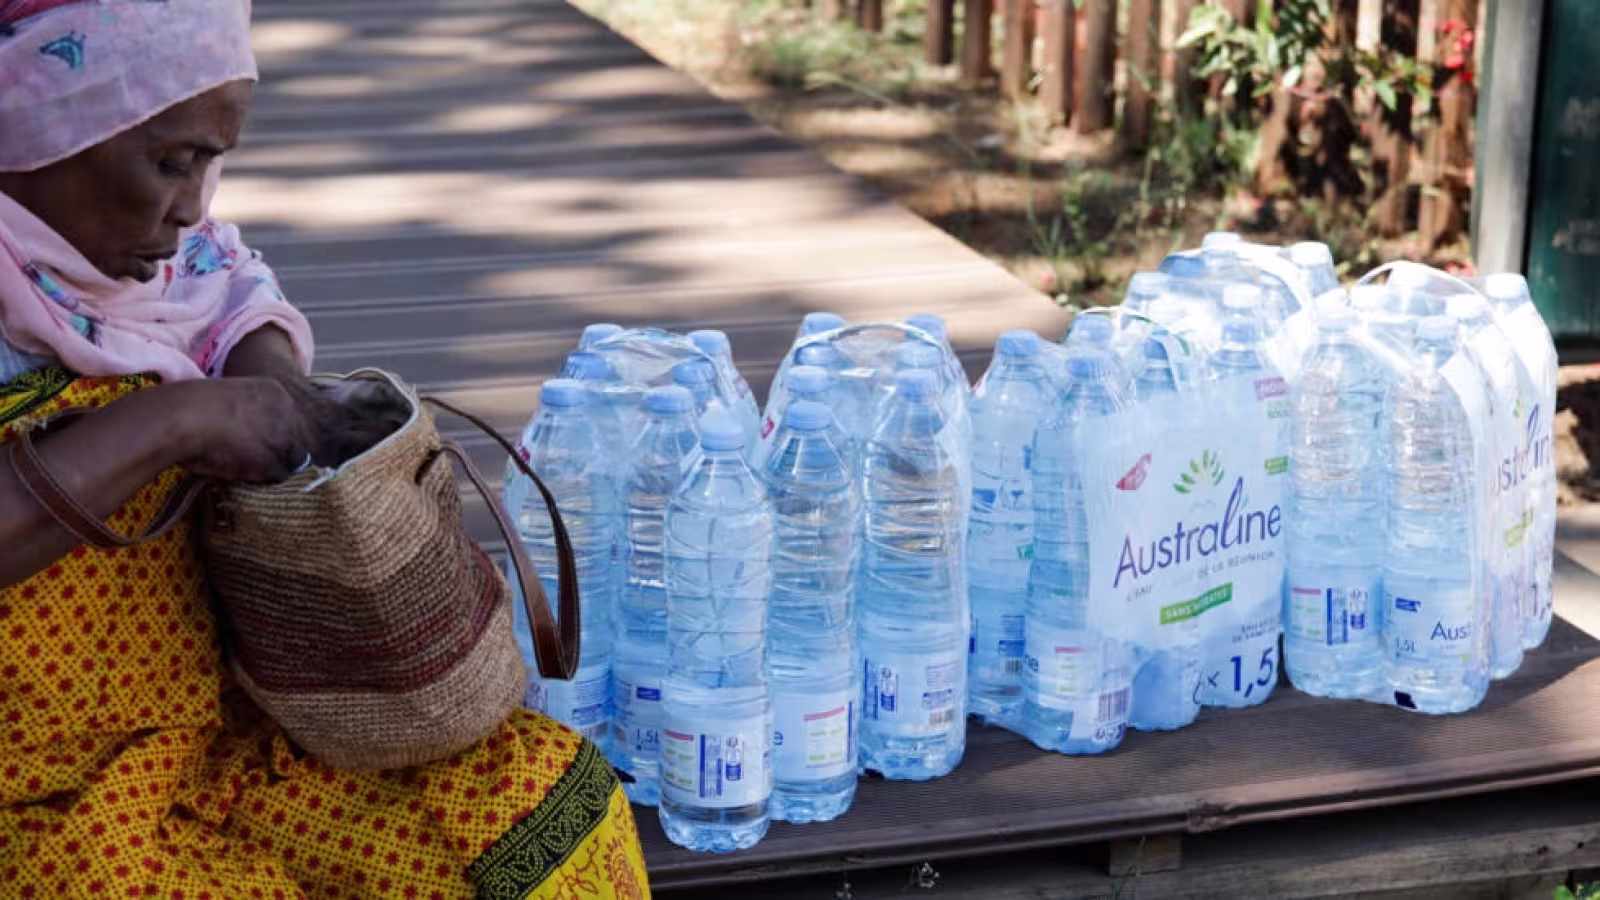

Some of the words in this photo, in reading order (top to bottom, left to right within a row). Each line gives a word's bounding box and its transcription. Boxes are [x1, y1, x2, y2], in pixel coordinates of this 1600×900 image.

[1113, 476, 1281, 589] Australine
[1165, 605, 1193, 620] SANS
[1230, 646, 1274, 697] 1,5
